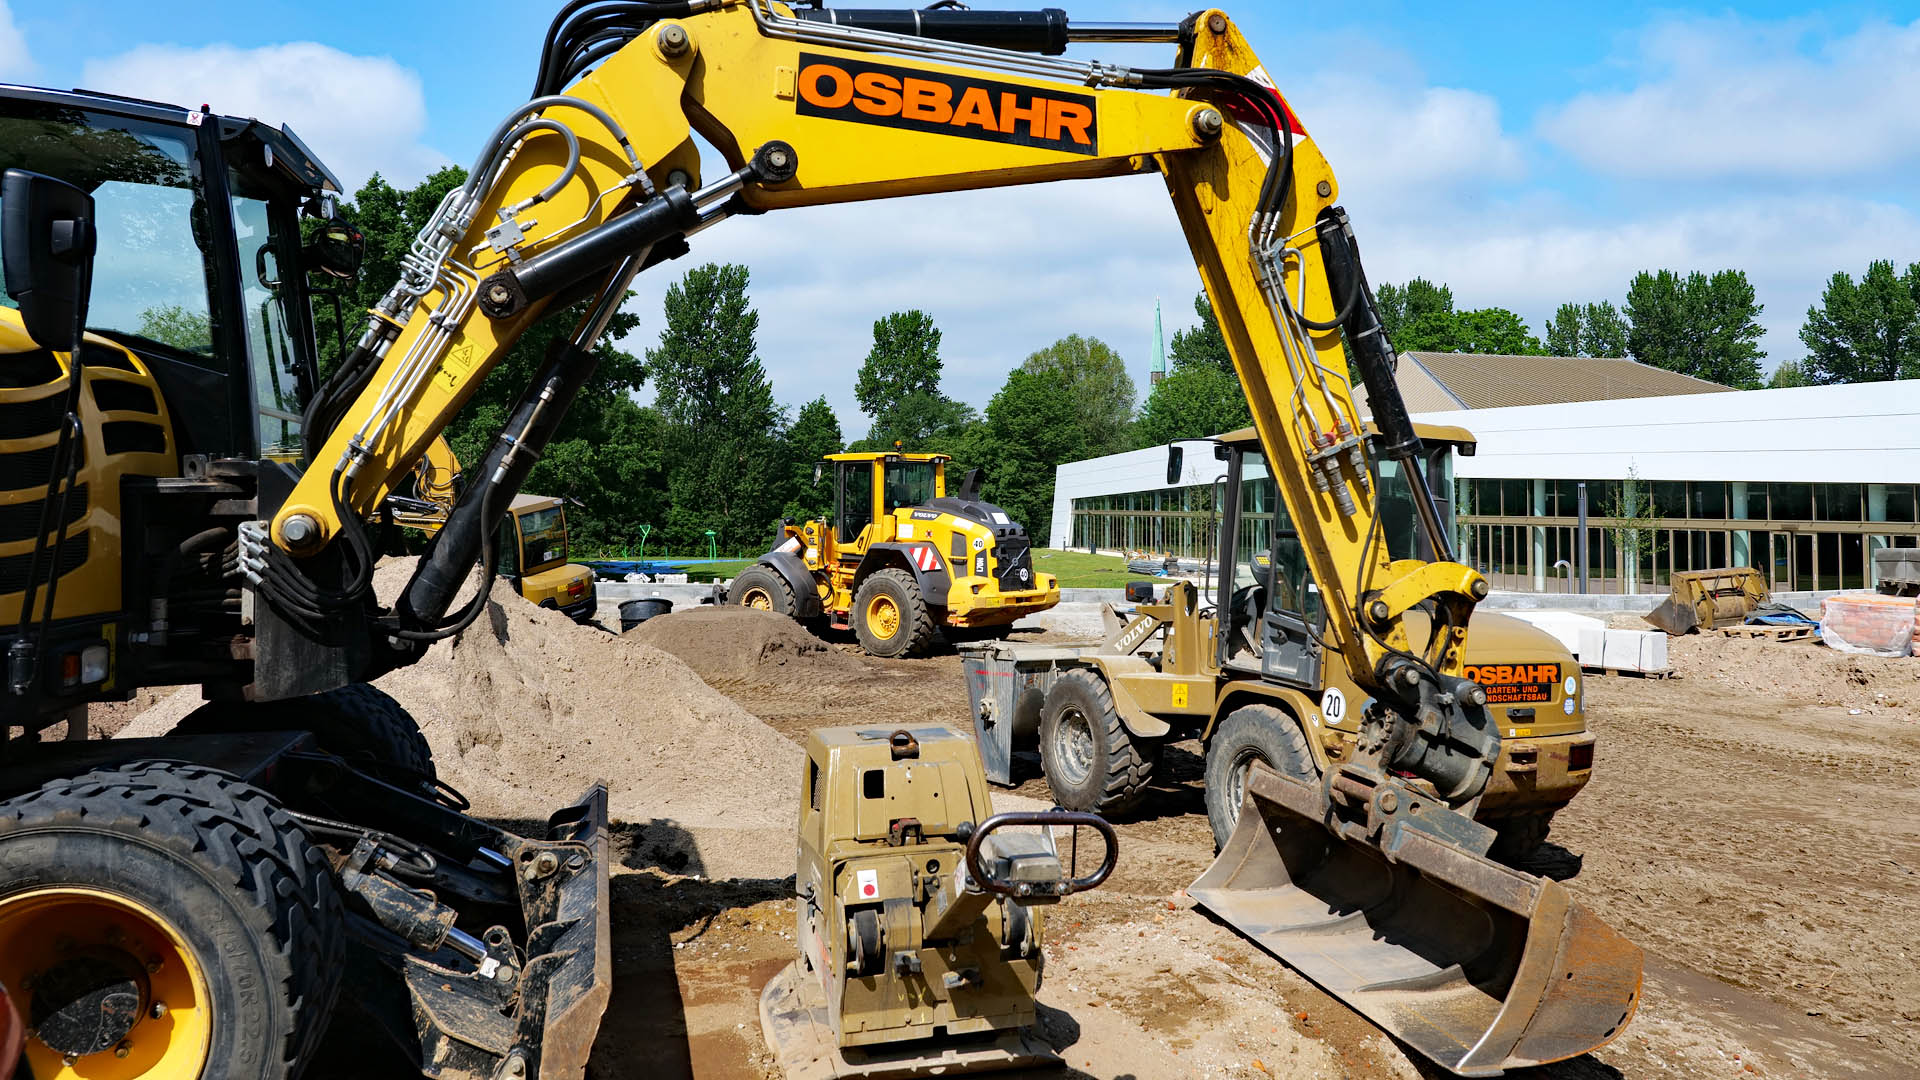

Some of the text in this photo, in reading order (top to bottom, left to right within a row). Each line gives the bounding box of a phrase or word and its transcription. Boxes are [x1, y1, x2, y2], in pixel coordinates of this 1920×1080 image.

[798, 63, 1093, 145] OSBAHR
[914, 511, 938, 519] VOLVO
[973, 540, 983, 548] 40
[1021, 569, 1028, 579] 40
[1114, 615, 1153, 652] VOLVO
[1463, 664, 1558, 685] OSBAHR
[1486, 685, 1538, 694] GARTEN- UND
[1487, 692, 1547, 702] NDSCHAFTSBAU
[1326, 694, 1341, 718] 20
